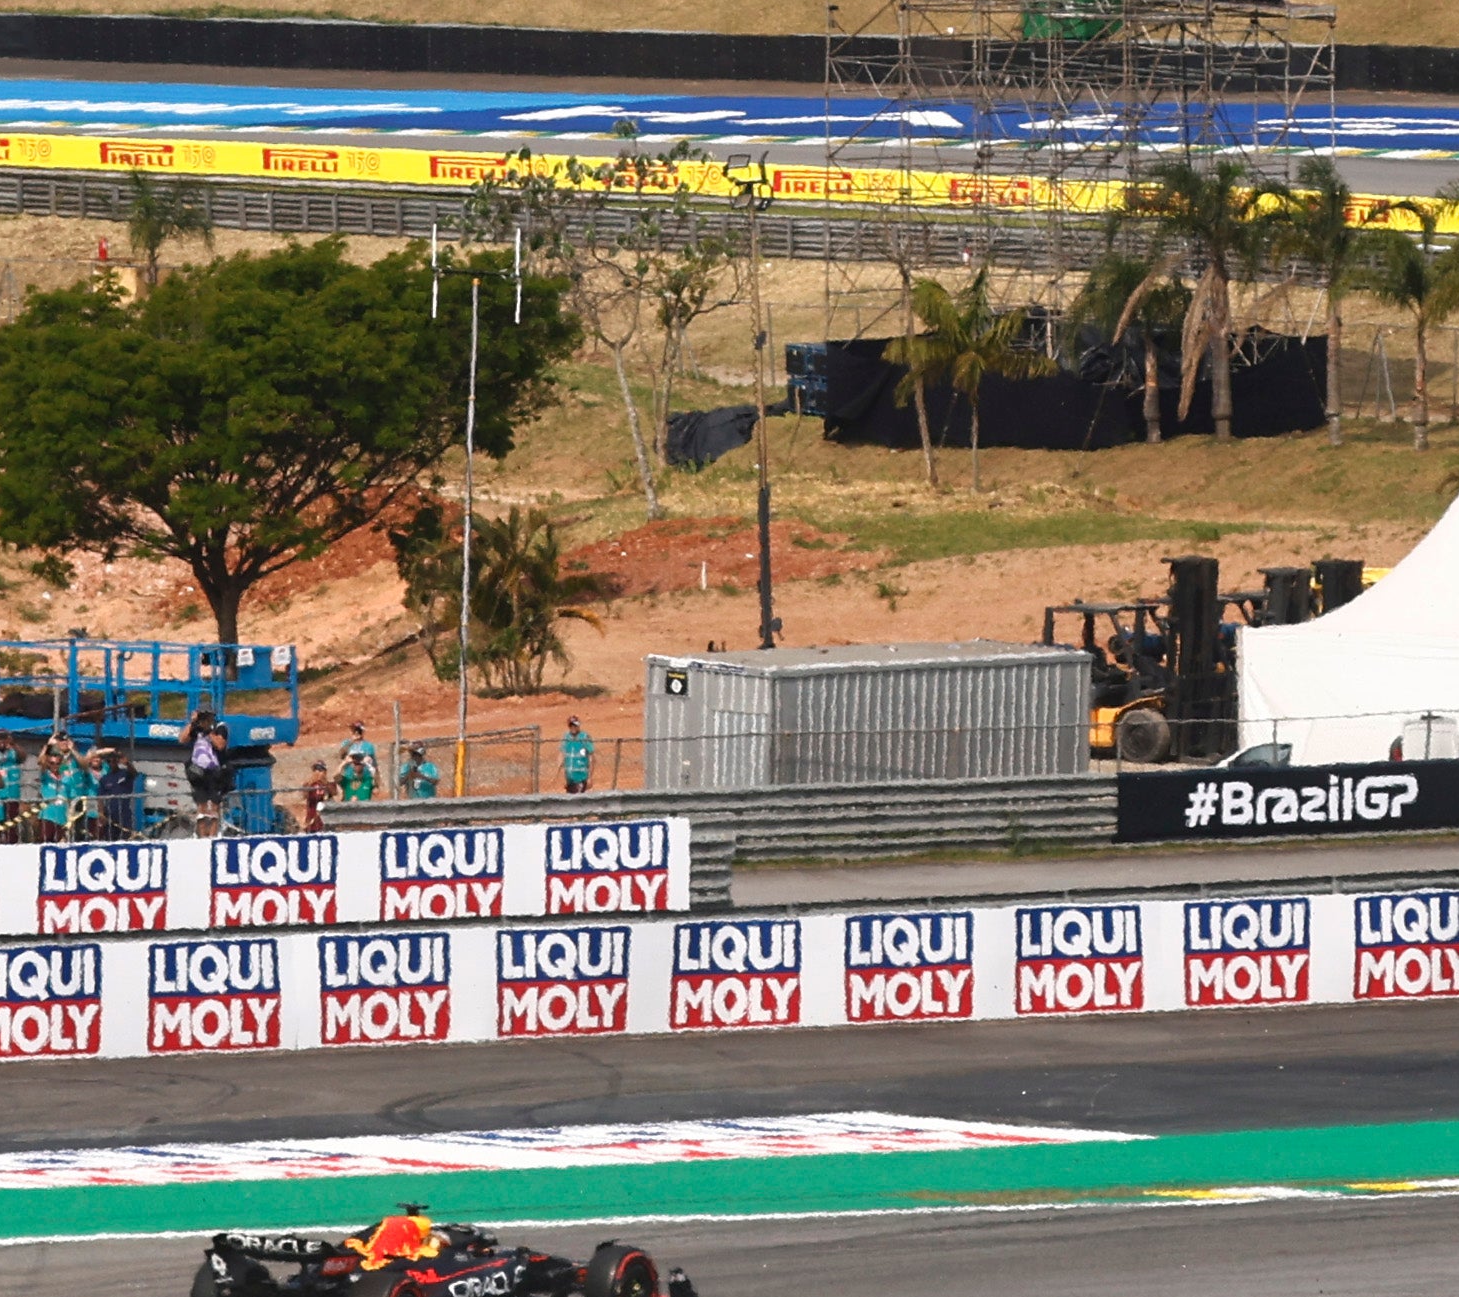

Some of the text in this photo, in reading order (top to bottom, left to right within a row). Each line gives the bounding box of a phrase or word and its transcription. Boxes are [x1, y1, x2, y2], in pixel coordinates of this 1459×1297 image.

[263, 149, 338, 173] PIRELLI
[1185, 774, 1418, 828] #BrazilGP
[850, 916, 969, 965] LIQUI
[1189, 902, 1305, 951] LIQUI
[152, 943, 276, 994] LIQUI
[503, 930, 623, 980] LIQUI
[1189, 953, 1305, 1002] MOLY
[503, 982, 623, 1032] MOLY
[850, 967, 969, 1018] MOLY
[152, 996, 276, 1048] MOLY
